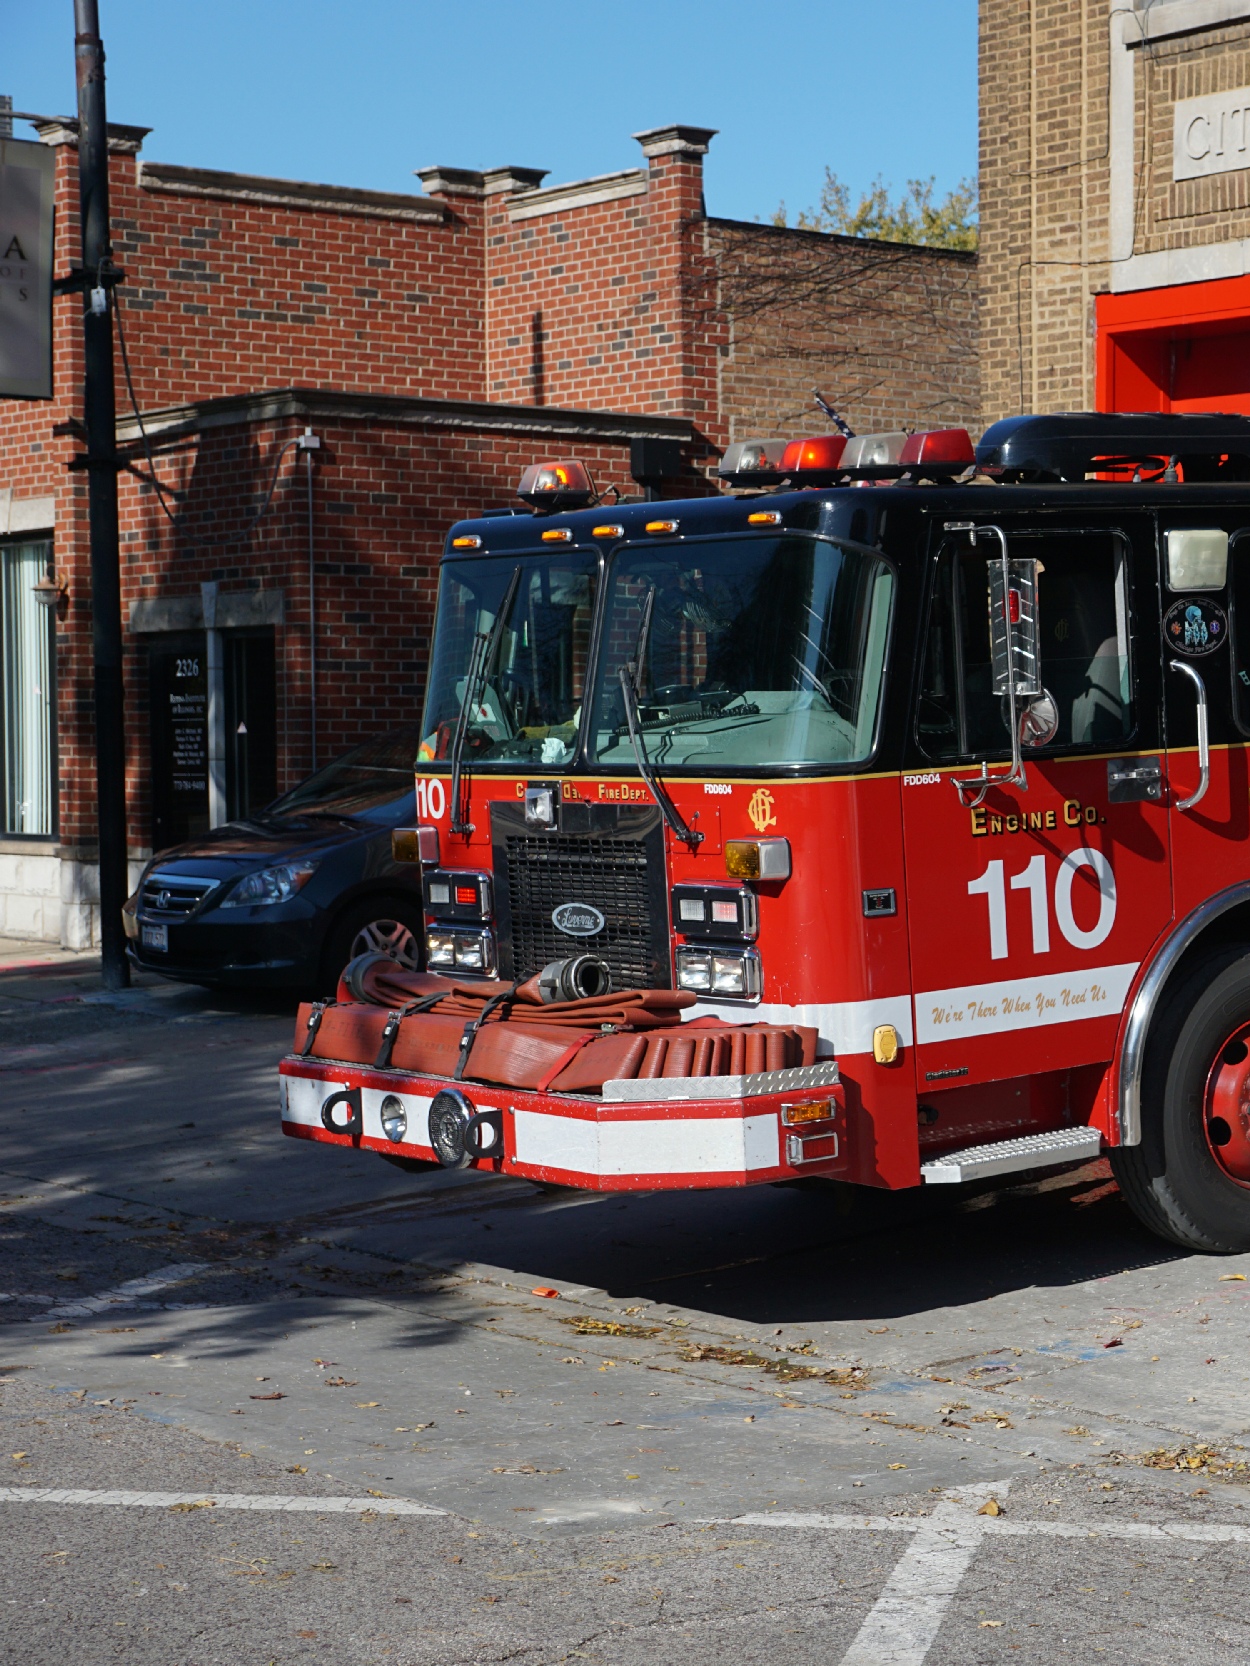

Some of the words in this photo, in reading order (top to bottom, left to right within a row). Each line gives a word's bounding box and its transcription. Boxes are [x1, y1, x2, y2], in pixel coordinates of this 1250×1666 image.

[176, 659, 199, 677] 2326
[704, 783, 732, 795] FDD604
[904, 773, 942, 787] FDD604
[598, 783, 620, 801] FIRE
[970, 807, 1057, 838] ENGINE
[967, 847, 1117, 960] 110
[932, 1005, 963, 1025] We're
[967, 1000, 998, 1021] There
[1001, 995, 1032, 1015] When
[1035, 992, 1057, 1018] You
[1060, 987, 1088, 1007] Need
[1090, 984, 1107, 1001] Us
